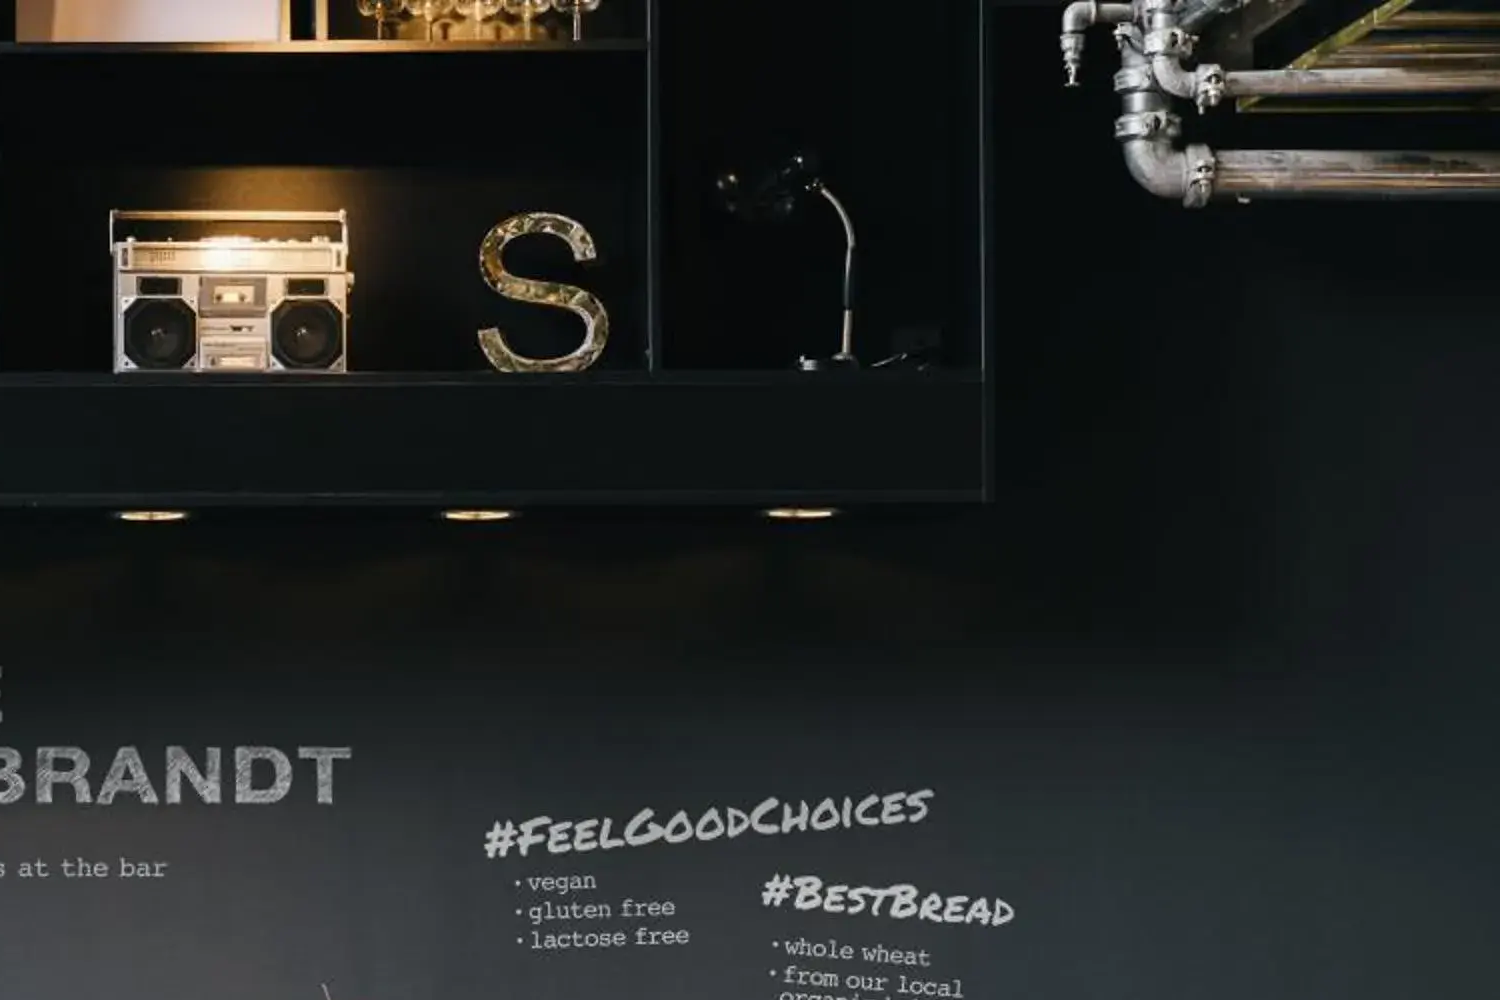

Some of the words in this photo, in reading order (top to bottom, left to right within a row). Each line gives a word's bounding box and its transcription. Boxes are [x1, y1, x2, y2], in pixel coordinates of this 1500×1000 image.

[478, 212, 609, 372] S
[18, 859, 49, 877] at
[61, 857, 108, 877] the
[120, 857, 167, 877] bar
[527, 875, 596, 894] vegan
[529, 901, 611, 924] gluten
[621, 899, 675, 917] free
[532, 931, 626, 949] lactose
[636, 928, 689, 944] free
[785, 938, 854, 959] whole
[862, 944, 930, 966] wheat
[784, 966, 838, 987] from
[846, 976, 888, 991] our
[897, 975, 963, 998] local
